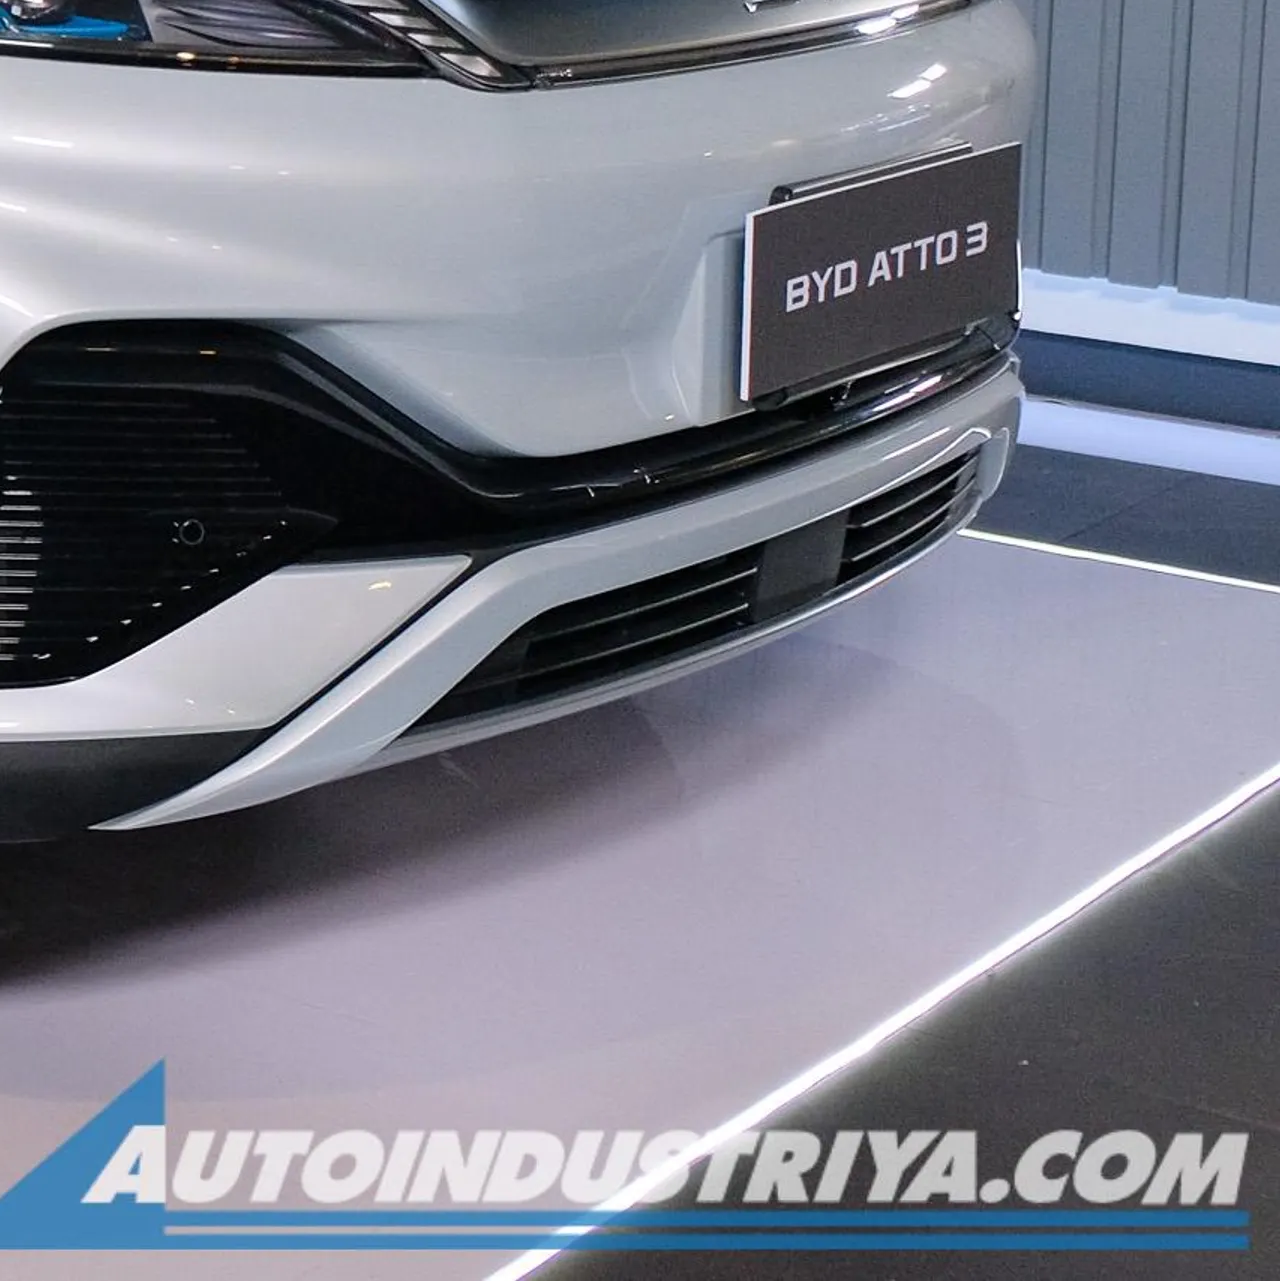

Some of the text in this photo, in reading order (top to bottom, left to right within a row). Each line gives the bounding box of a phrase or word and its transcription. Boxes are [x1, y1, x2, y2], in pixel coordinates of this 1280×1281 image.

[785, 220, 989, 313] BYD ATTO 3
